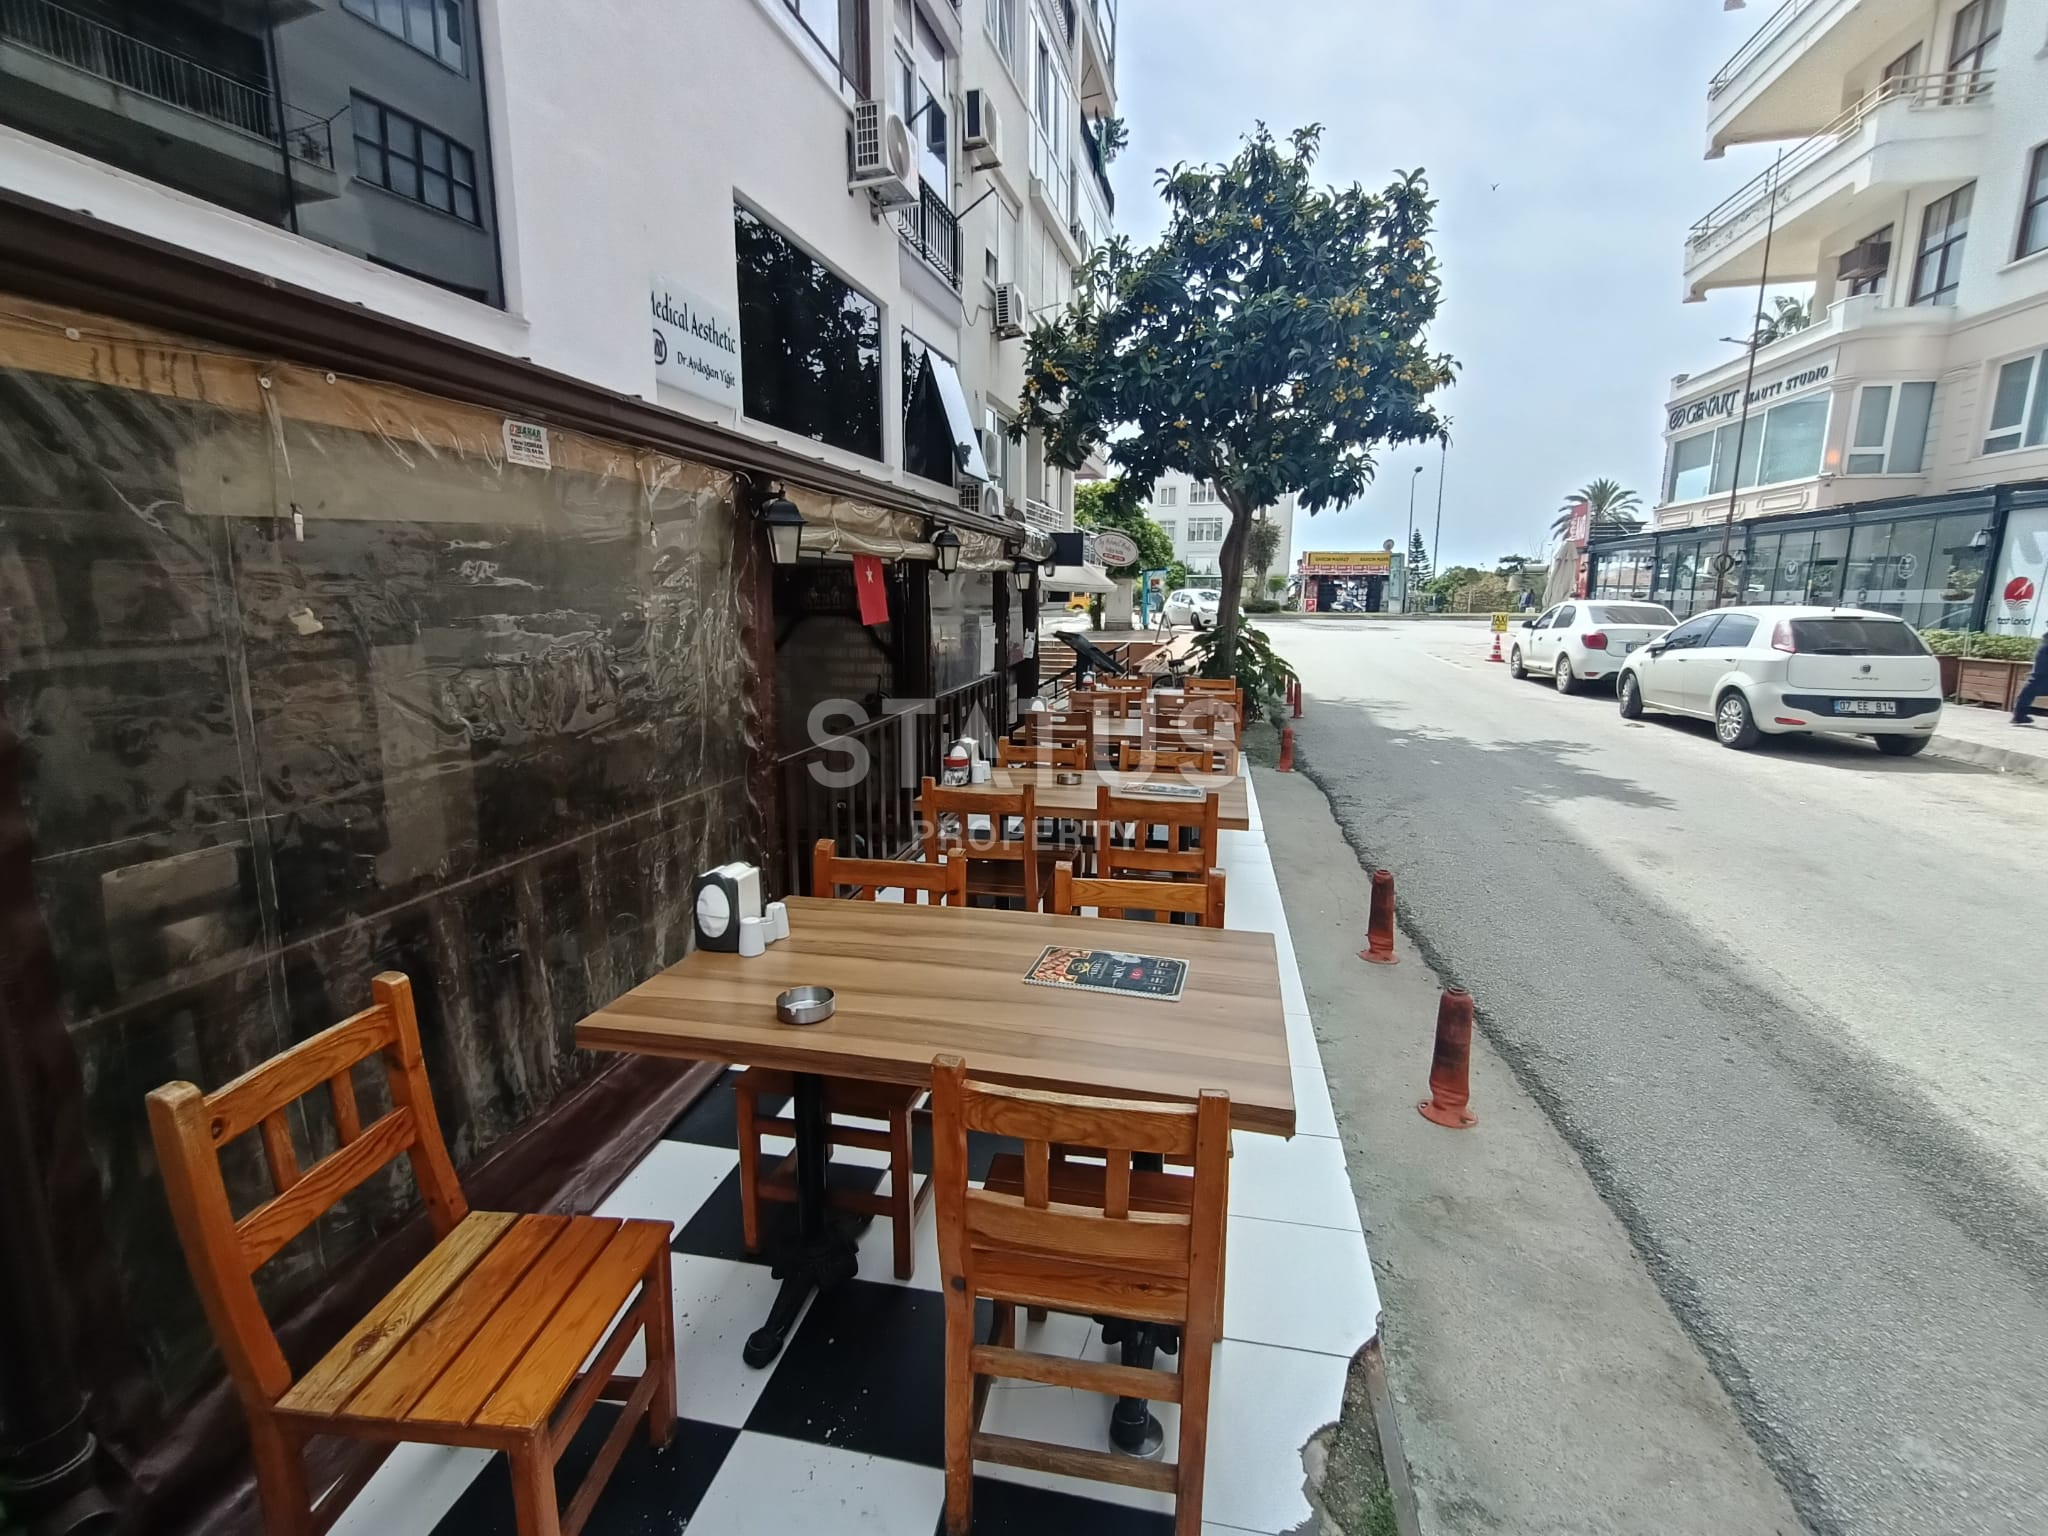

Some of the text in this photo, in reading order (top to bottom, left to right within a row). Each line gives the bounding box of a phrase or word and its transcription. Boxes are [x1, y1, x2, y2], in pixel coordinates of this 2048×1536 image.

[691, 312, 736, 354] Aesthetic
[1785, 365, 1829, 392] STUDIO
[1492, 613, 1509, 625] TAXI
[1839, 701, 1894, 712] 07 EE 814
